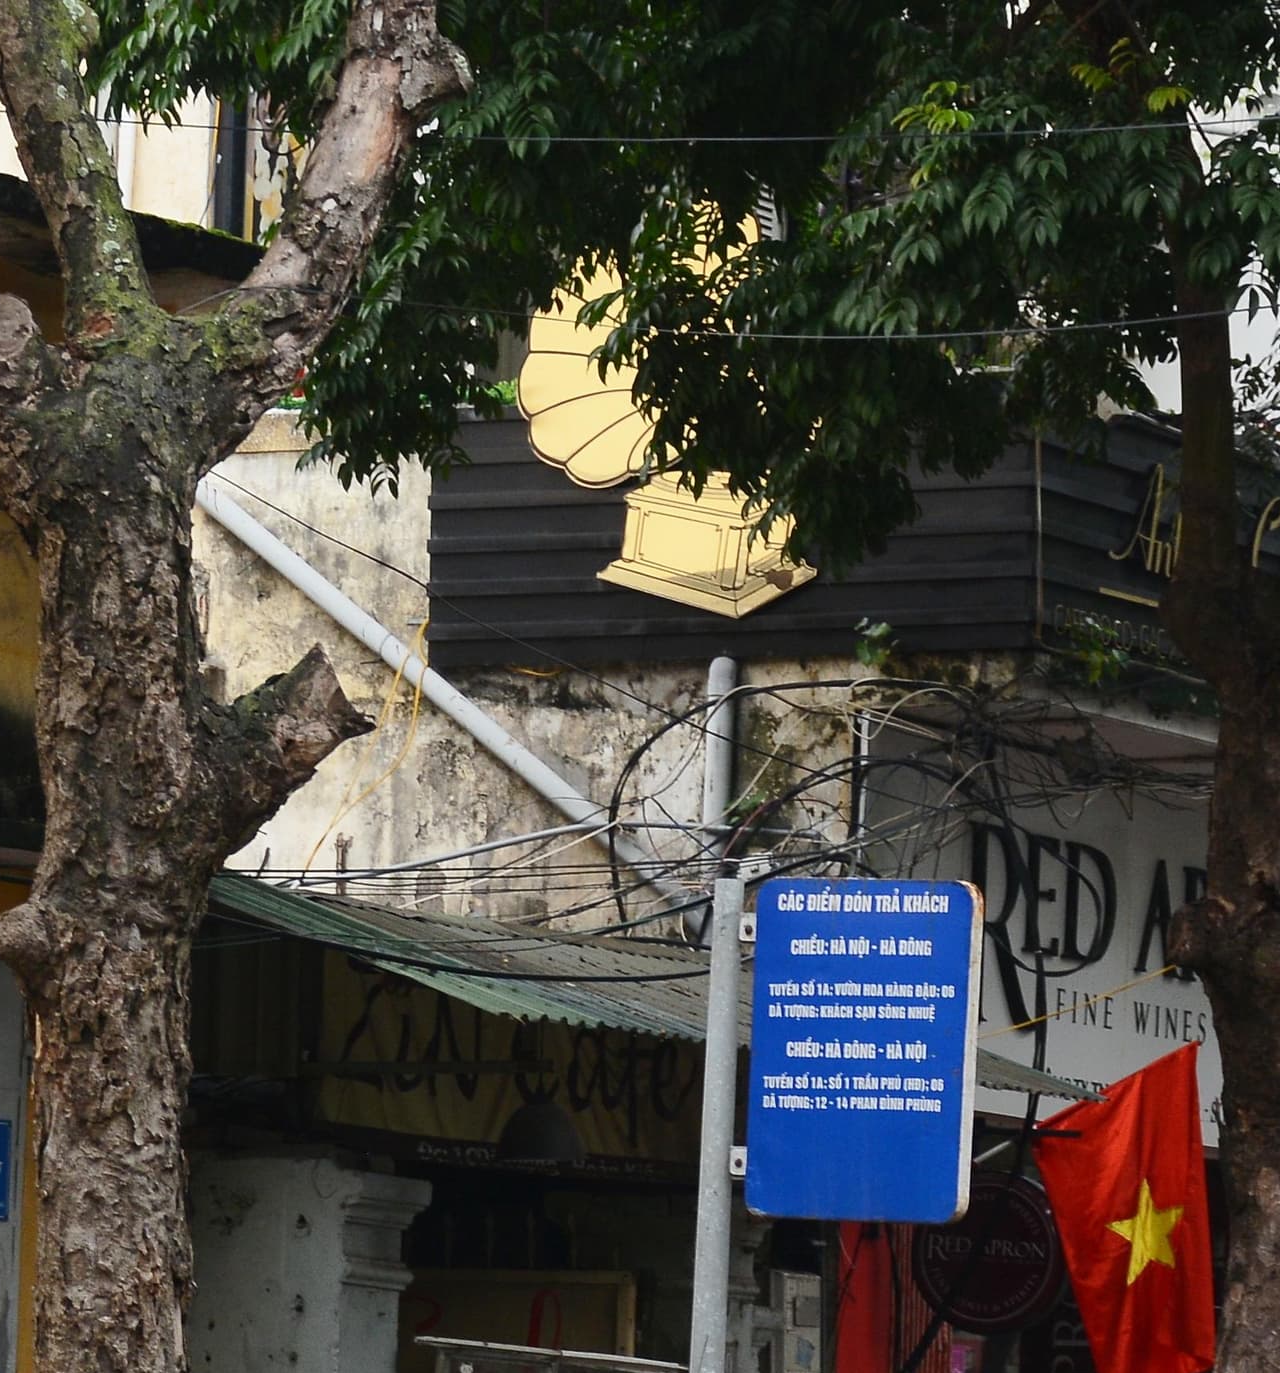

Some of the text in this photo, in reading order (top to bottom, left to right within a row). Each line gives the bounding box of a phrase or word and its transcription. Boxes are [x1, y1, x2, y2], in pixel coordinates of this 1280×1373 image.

[778, 886, 950, 913] CÁC ĐIỂM ĐÓN TRẢ KHÁCH
[971, 821, 1117, 1031] RED
[830, 935, 847, 956] HÀ
[848, 936, 870, 959] NỘI
[879, 936, 897, 956] HÀ
[897, 936, 933, 957] ĐÔNG
[769, 979, 800, 997] TUYẾN
[801, 979, 816, 997] SỐ
[863, 984, 884, 998] HOA
[885, 981, 914, 999] HÀNG
[821, 1003, 854, 1019] KHÁCH
[854, 1005, 876, 1022] SẠN
[877, 1003, 906, 1020] SÔNG
[907, 1004, 936, 1023] NHUỆ
[1056, 986, 1208, 1047] FINE WINES
[825, 1039, 842, 1059] HÀ
[843, 1040, 877, 1060] ĐÔNG
[886, 1040, 903, 1060] HÀ
[904, 1040, 928, 1063] NỘI
[763, 1072, 794, 1089] TUYẾN
[794, 1072, 810, 1090] SỐ
[828, 1073, 844, 1090] SỐ
[850, 1097, 878, 1111] PHAN
[905, 1096, 942, 1113] PHÙNG
[928, 1233, 973, 1261] RED
